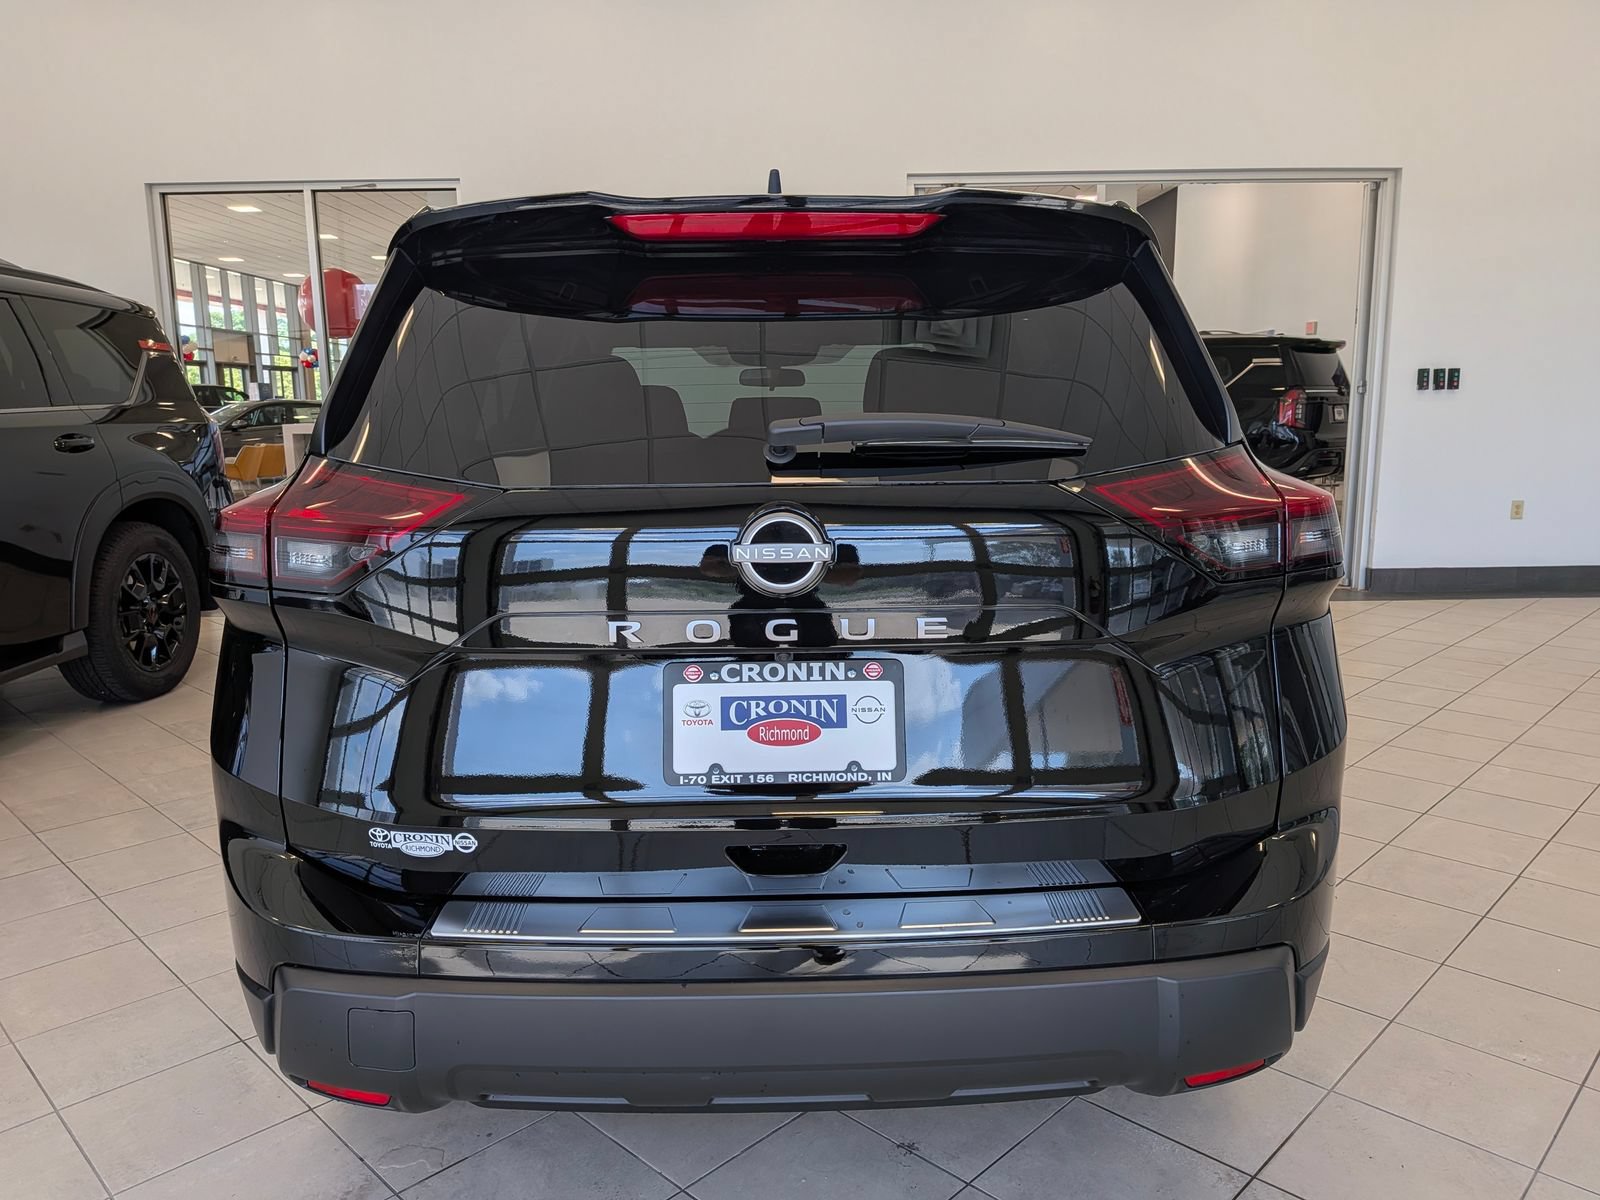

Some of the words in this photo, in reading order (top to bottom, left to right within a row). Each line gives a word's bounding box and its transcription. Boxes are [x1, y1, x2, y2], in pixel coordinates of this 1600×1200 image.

[735, 546, 831, 560] NISSAN
[607, 617, 949, 643] ROGUE
[720, 662, 846, 682] CRONIN
[729, 699, 838, 725] CRONIN
[759, 726, 809, 742] Richmond
[680, 775, 706, 784] I-70
[711, 774, 743, 784] EXIT
[748, 774, 774, 783] 156
[788, 772, 872, 783] RICHMOND,
[877, 772, 892, 781] IN
[370, 841, 392, 849] TOYOTA
[393, 832, 450, 846] CRONIN
[405, 845, 441, 853] RICHMOND
